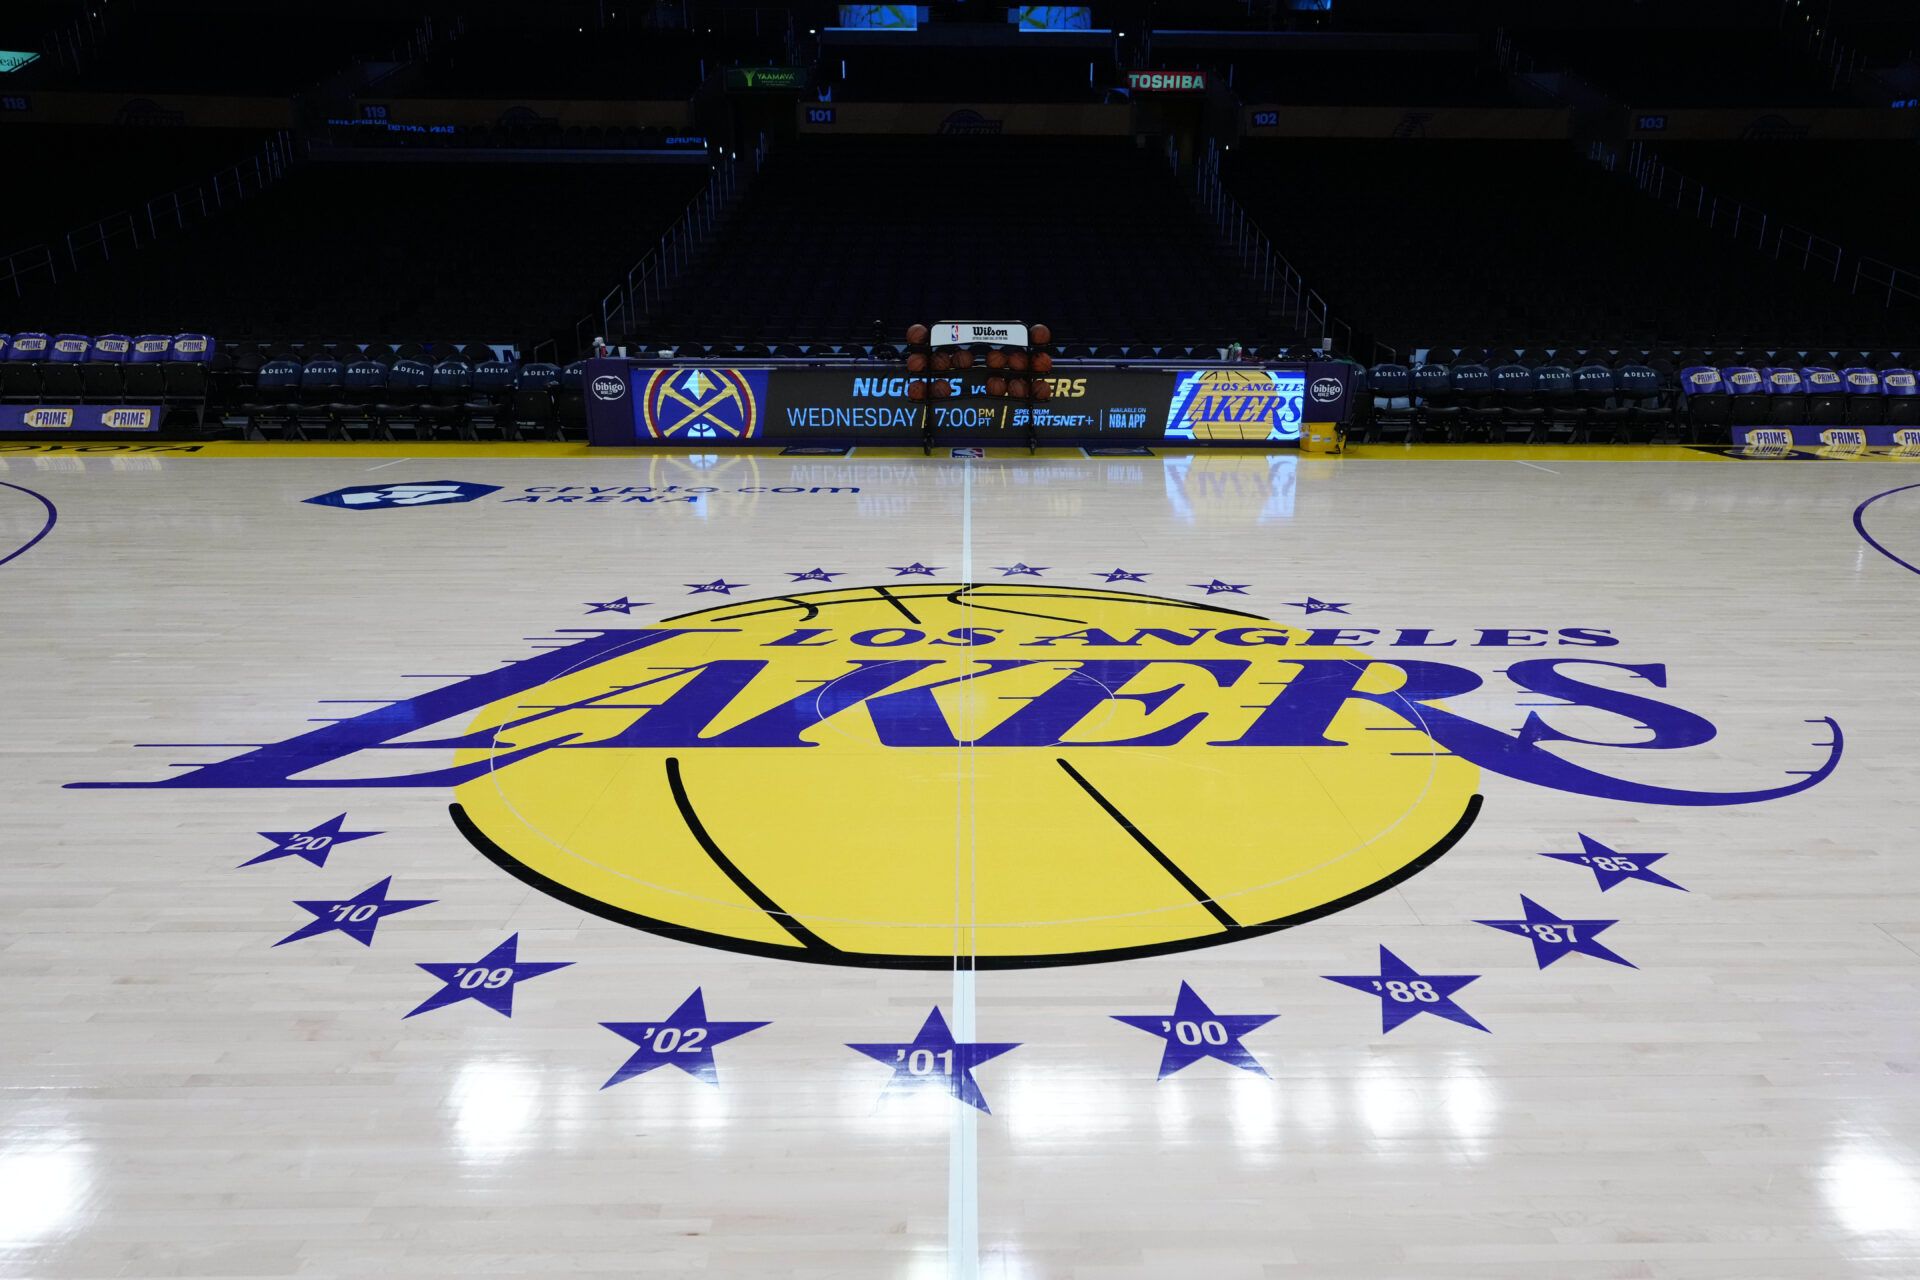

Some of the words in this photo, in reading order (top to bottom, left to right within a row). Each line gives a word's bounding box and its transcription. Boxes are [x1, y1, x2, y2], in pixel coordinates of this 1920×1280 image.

[1128, 74, 1204, 89] TOSHIBA
[364, 105, 387, 118] 119
[809, 109, 832, 122] 101
[1253, 112, 1278, 125] 102
[1639, 117, 1664, 129] 103
[972, 326, 1008, 336] Wilson
[21, 339, 42, 349] PRIME
[62, 341, 84, 351] PRIME
[103, 340, 125, 351] PRIME
[143, 340, 164, 351] PRIME
[182, 340, 203, 351] PRIME
[400, 366, 424, 375] DELTA
[1697, 373, 1717, 383] PRIME
[1737, 373, 1758, 383] PRIME
[1777, 373, 1798, 383] PRIME
[1817, 373, 1837, 382] PRIME
[1854, 374, 1874, 384] PRIME
[1891, 375, 1912, 385] PRIME
[595, 382, 623, 393] bibigo
[853, 377, 963, 397] NUGS
[1212, 382, 1239, 392] LOS
[1313, 384, 1341, 395] bibigo
[1166, 382, 1304, 434] LAKERS
[35, 410, 67, 425] PRIME
[113, 410, 145, 425] PRIME
[787, 407, 917, 427] WEDNESDAY
[934, 407, 977, 427] 7:00
[978, 408, 995, 418] PM
[978, 417, 991, 427] PT
[1109, 414, 1127, 428] NBA
[1128, 414, 1146, 428] APP
[1756, 431, 1788, 445] PRIME
[1830, 431, 1862, 445] PRIME
[524, 485, 861, 495] crypto.com
[503, 495, 698, 503] ARENA
[760, 628, 1004, 647] LOS
[1018, 628, 1620, 647] ANGELES
[62, 628, 1844, 806] LAKERS
